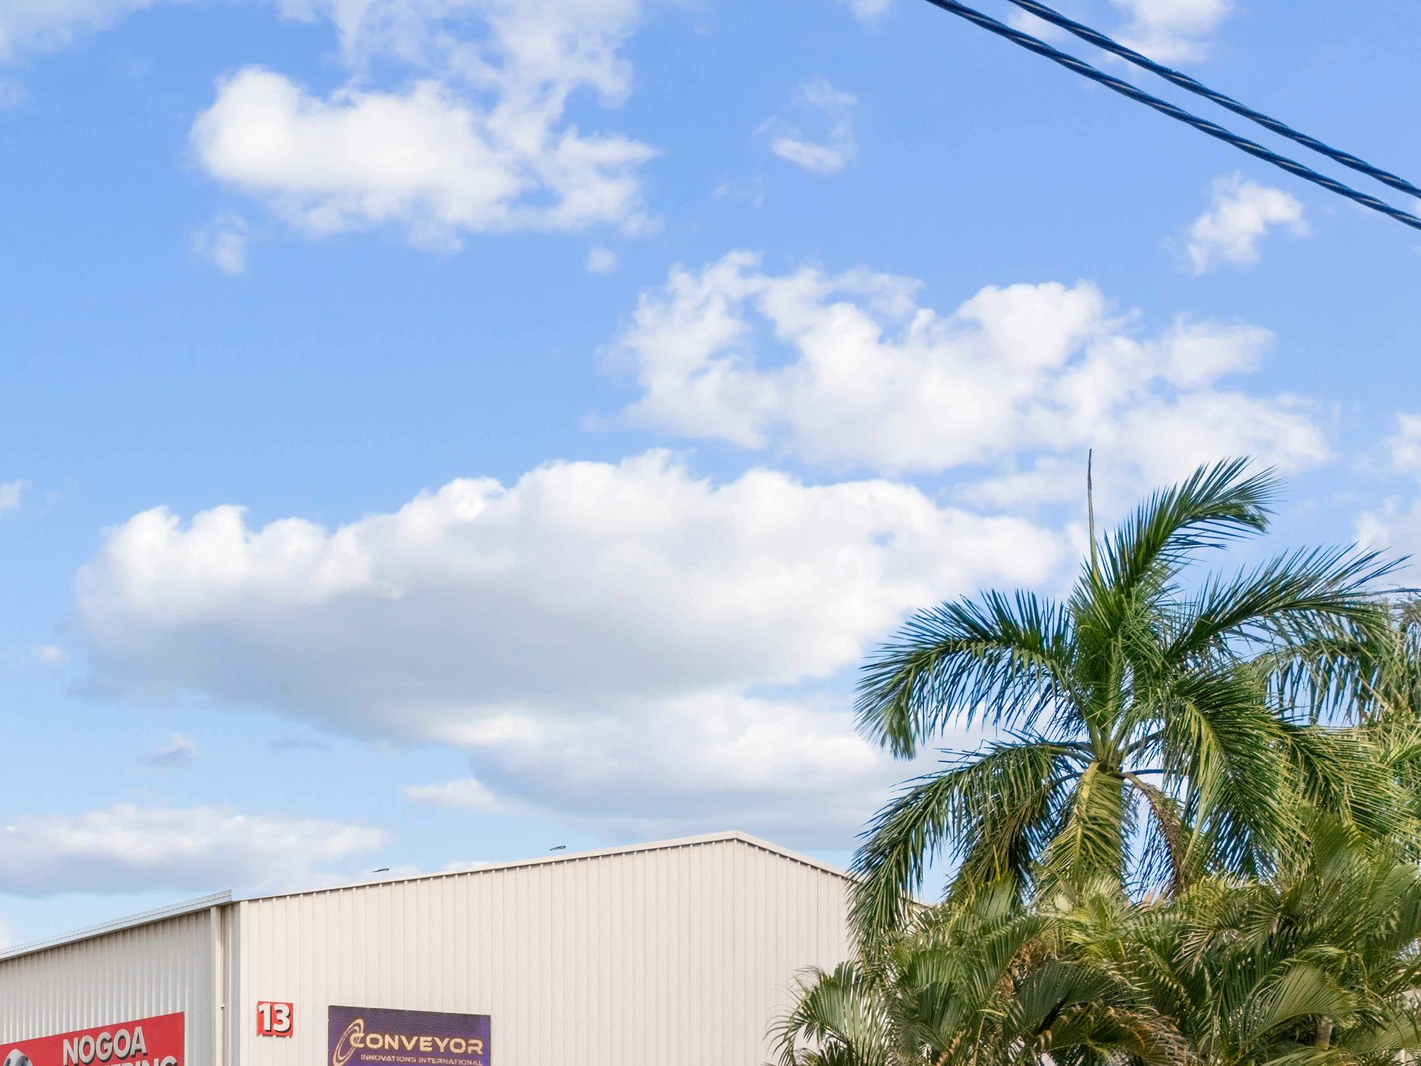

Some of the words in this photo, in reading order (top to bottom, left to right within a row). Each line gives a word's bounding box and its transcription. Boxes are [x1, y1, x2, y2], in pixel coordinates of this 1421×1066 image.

[258, 1002, 291, 1033] 13
[63, 1026, 147, 1066] NOGOA
[350, 1033, 484, 1055] CONVEYOR
[361, 1054, 417, 1063] INNOVATIONS
[418, 1057, 484, 1066] INTERNATIONAL
